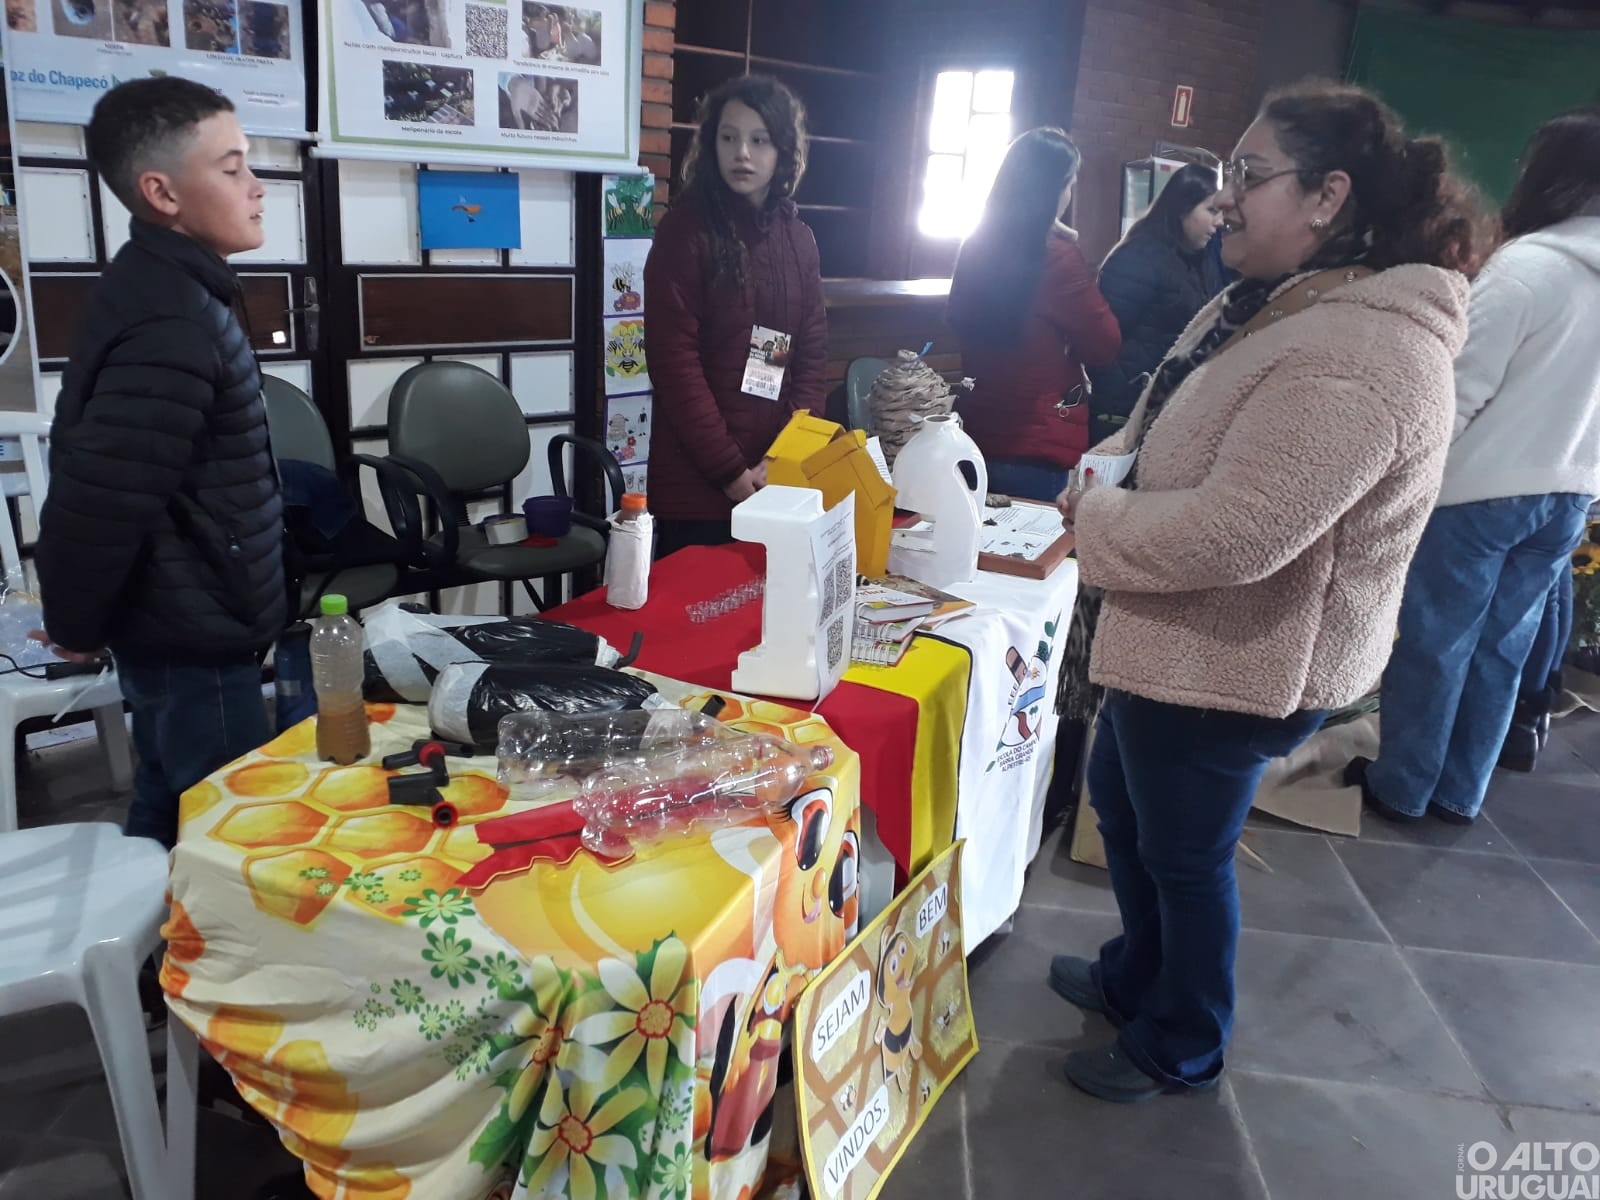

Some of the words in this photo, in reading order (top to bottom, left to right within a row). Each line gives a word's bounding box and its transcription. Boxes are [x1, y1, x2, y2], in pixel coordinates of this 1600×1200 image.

[10, 70, 25, 82] oz
[28, 69, 46, 84] do
[49, 70, 108, 90] Chapecó
[1013, 746, 1022, 754] DO
[918, 888, 947, 932] BEM
[817, 979, 867, 1052] SEJAM
[828, 1106, 888, 1184] VINDOS.
